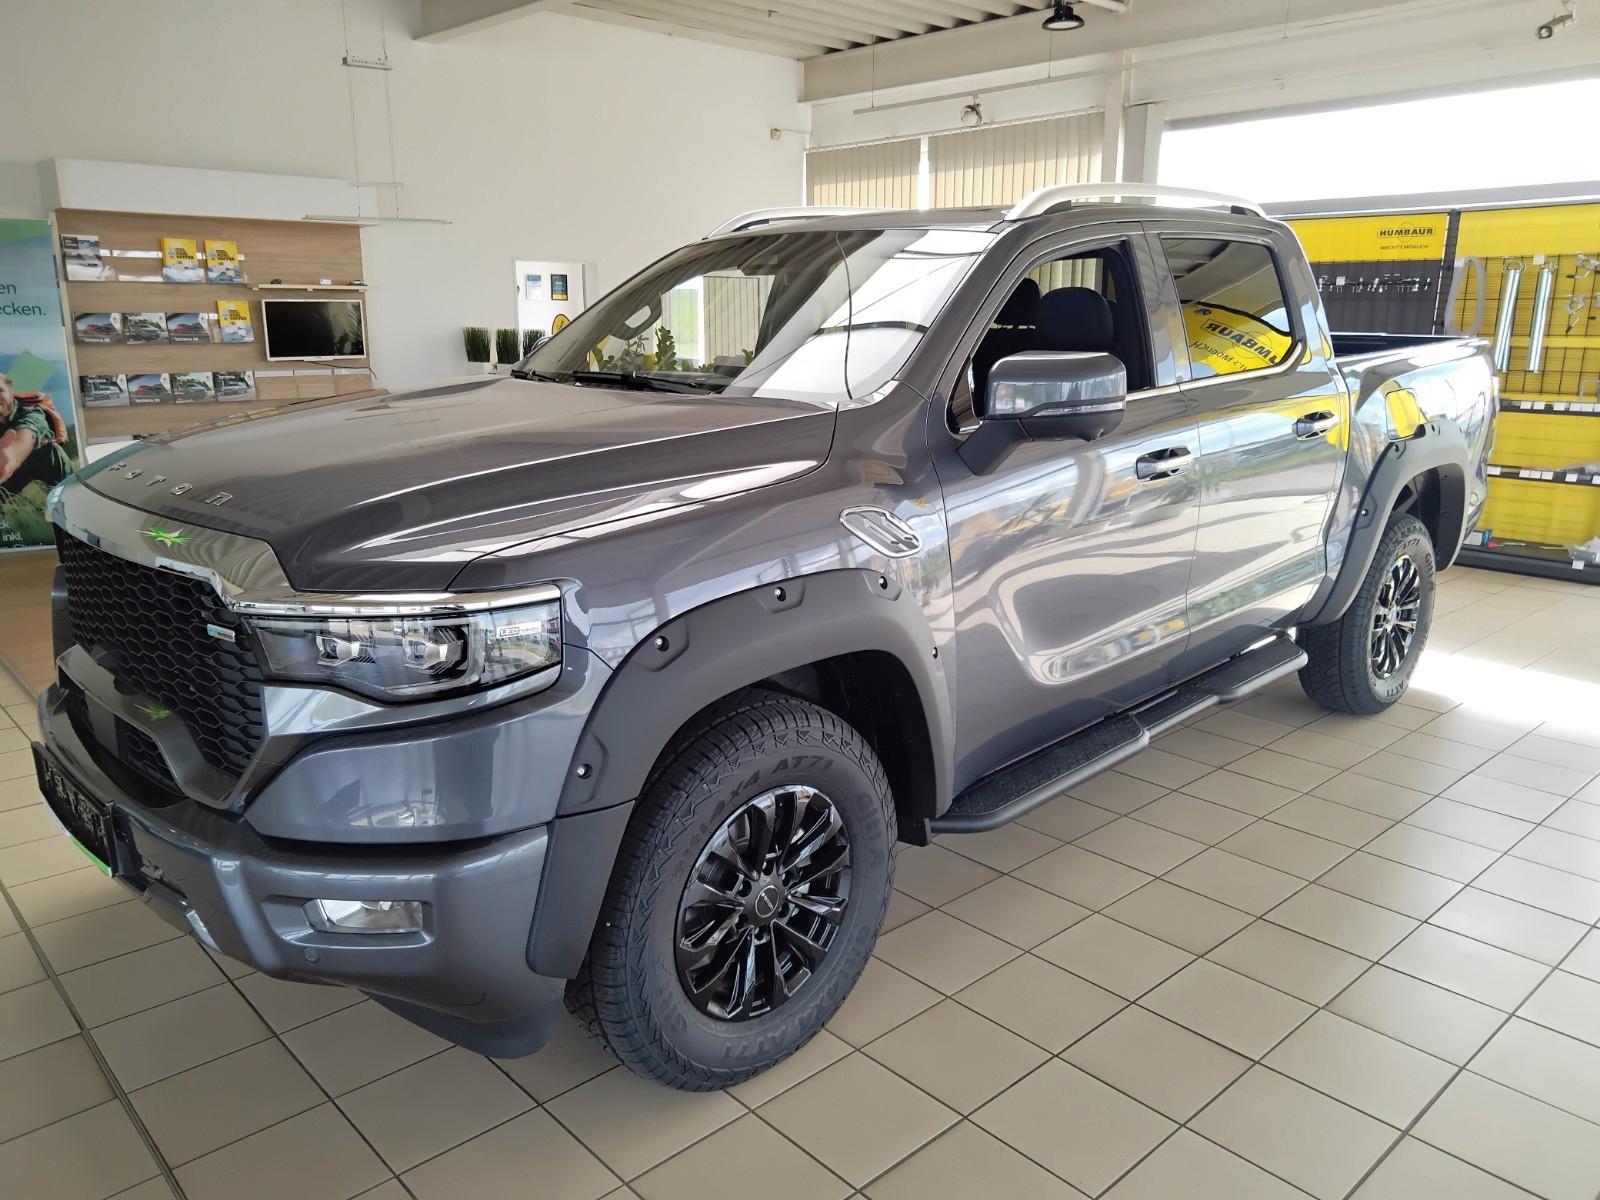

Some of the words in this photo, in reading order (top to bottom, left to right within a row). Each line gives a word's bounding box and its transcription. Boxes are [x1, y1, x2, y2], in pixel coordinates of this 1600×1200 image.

[1379, 228, 1433, 237] HUMBAUR
[0, 301, 47, 316] cken.
[771, 754, 834, 775] AT71
